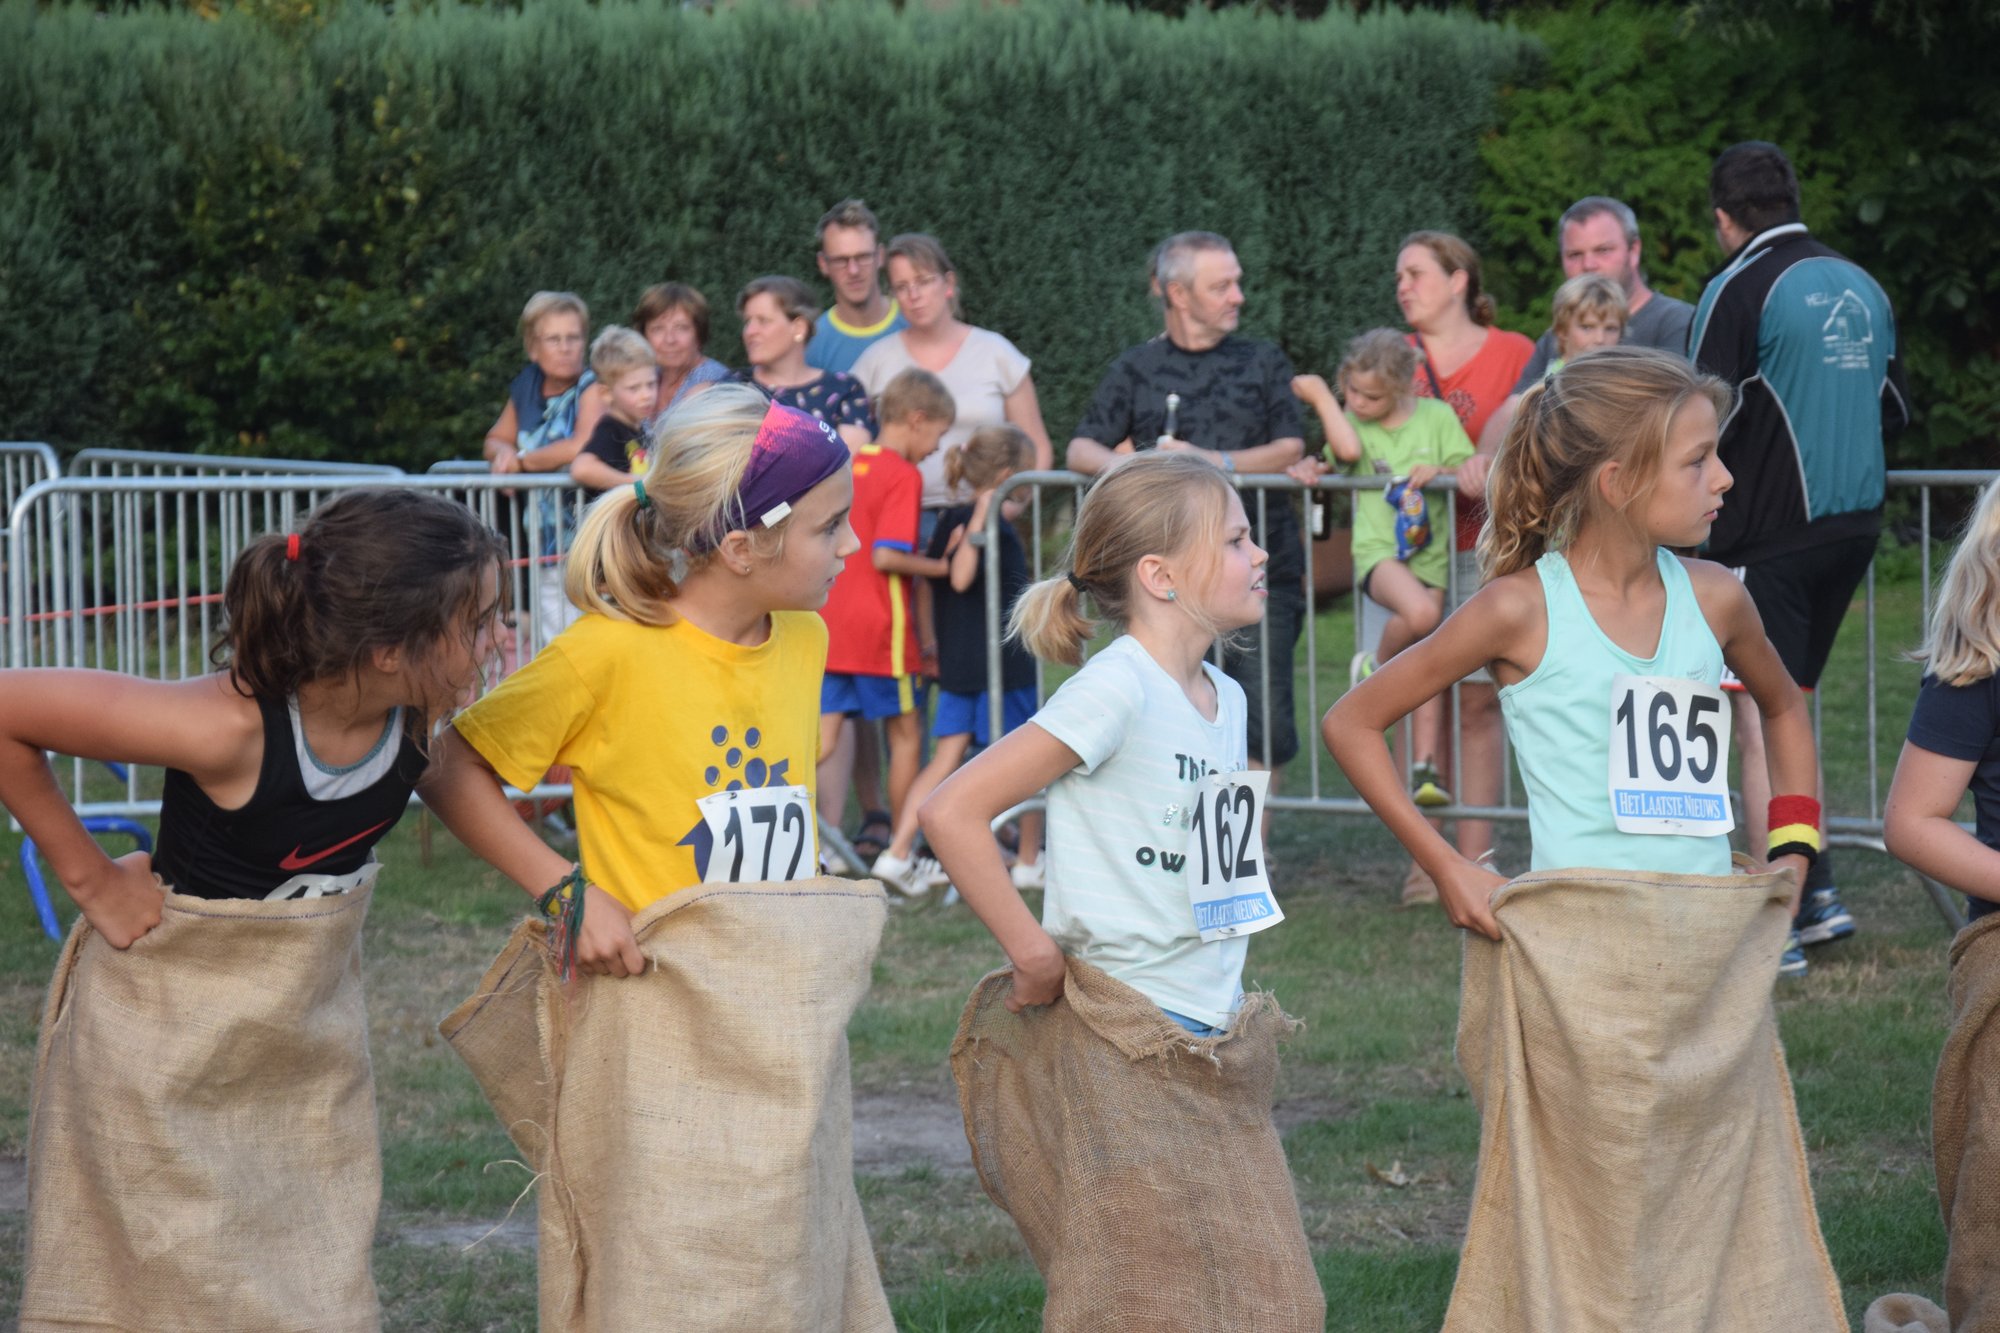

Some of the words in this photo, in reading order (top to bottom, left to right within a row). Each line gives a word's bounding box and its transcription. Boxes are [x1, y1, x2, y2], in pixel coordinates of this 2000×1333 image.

[1617, 689, 1720, 784] 165
[724, 802, 805, 883] 172
[1192, 785, 1258, 885] 162
[1619, 791, 1640, 815] HET
[1641, 793, 1684, 817] LAATSTE
[1684, 794, 1721, 819] NIEUWS
[1232, 897, 1268, 921] NIEUWS
